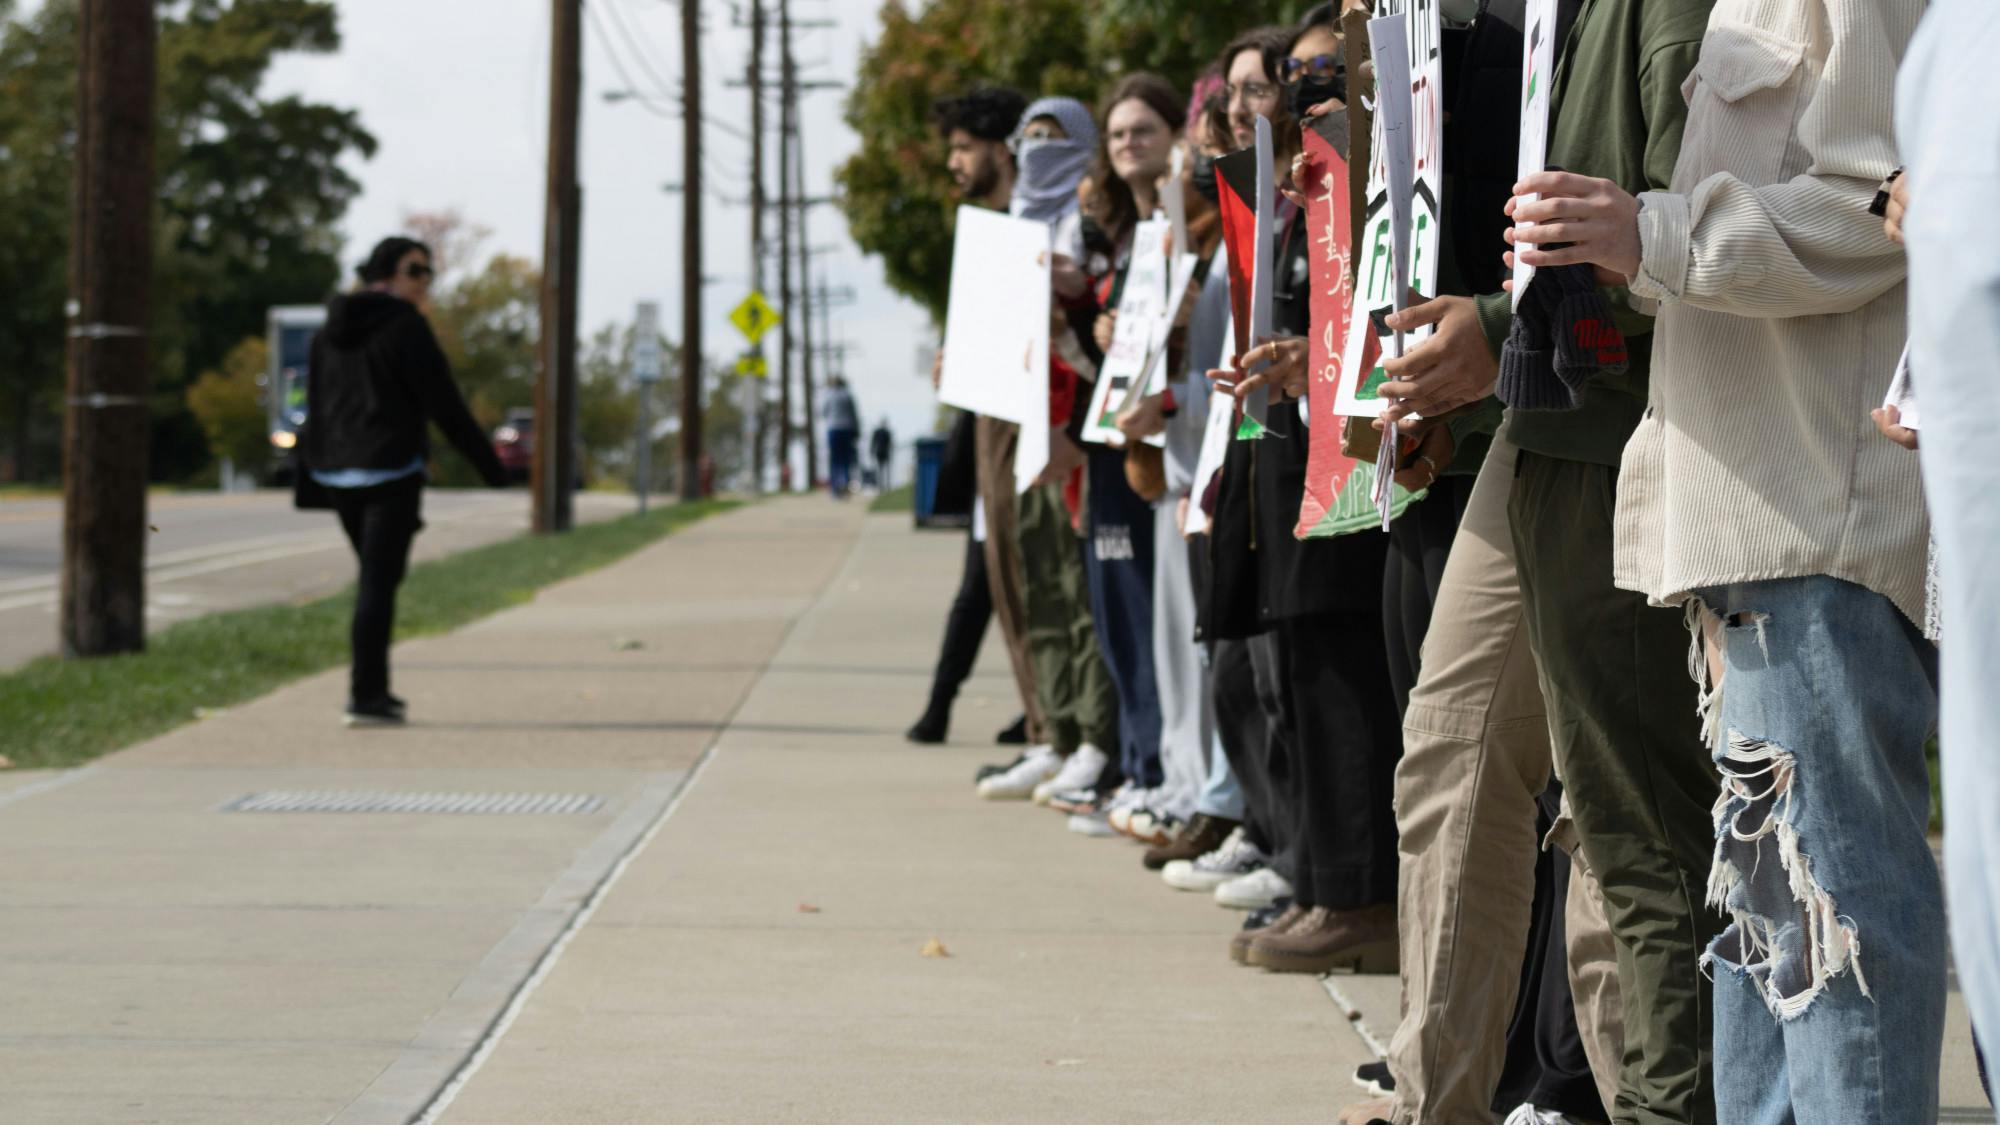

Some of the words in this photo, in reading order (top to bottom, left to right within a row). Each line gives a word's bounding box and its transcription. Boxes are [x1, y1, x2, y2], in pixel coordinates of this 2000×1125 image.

[1316, 172, 1345, 296] فلسطين
[1367, 213, 1428, 301] FE
[1317, 319, 1344, 383] حرة
